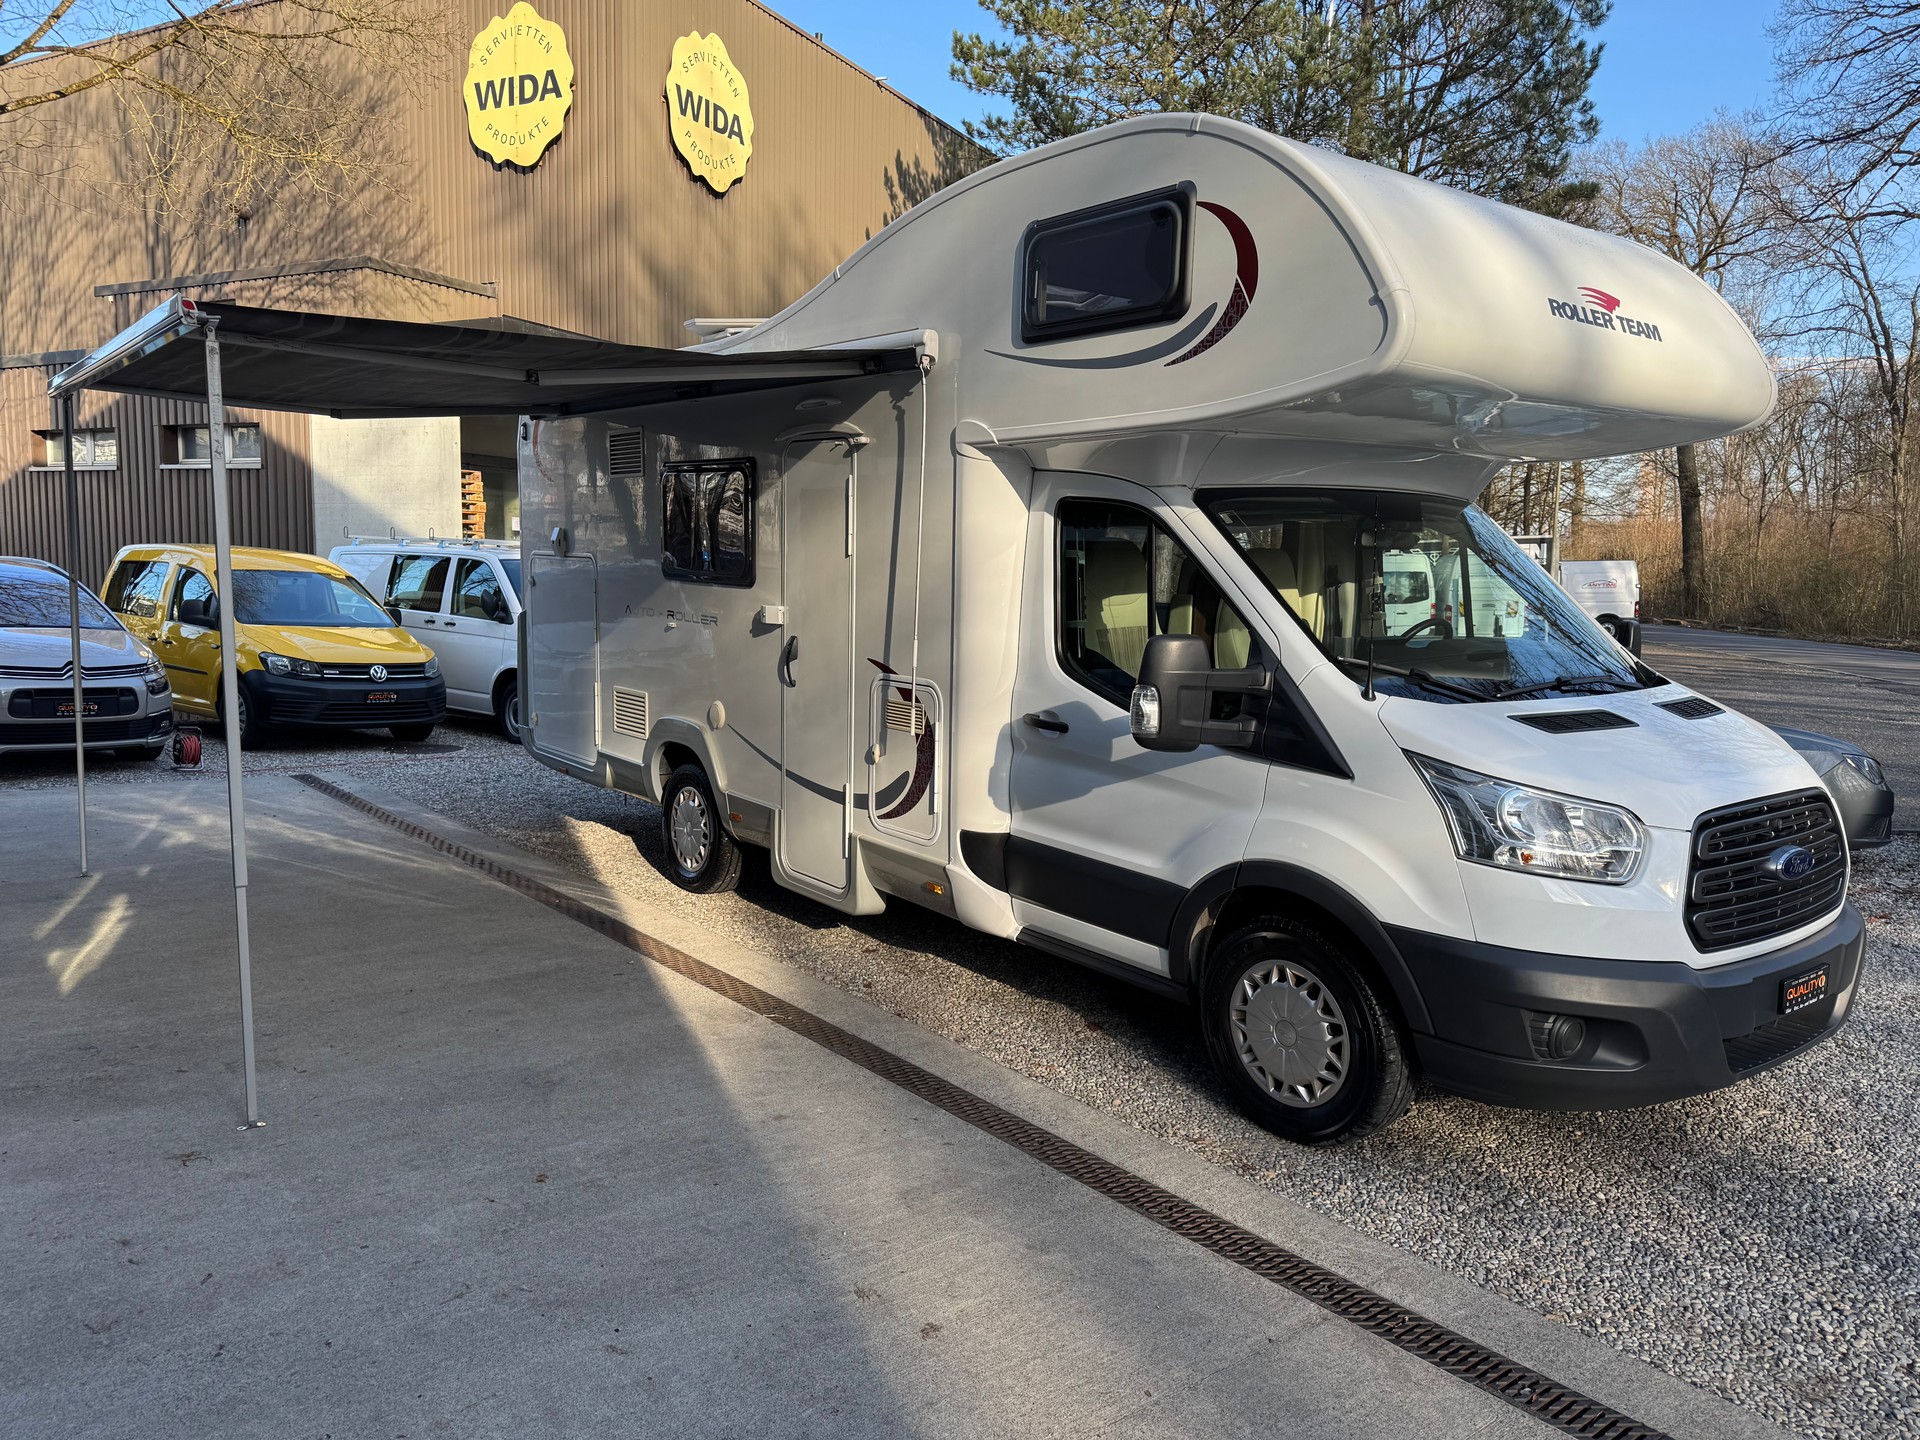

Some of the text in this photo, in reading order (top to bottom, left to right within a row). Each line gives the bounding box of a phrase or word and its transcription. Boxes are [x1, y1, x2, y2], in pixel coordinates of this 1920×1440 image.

[479, 25, 553, 66] SERVIETTEN
[474, 69, 563, 112] WIDA
[682, 51, 740, 98] SERVIETTEN
[485, 116, 550, 146] PRODUKTE
[675, 83, 745, 147] WIDA
[684, 130, 736, 170] PRODUKTE
[1547, 298, 1663, 342] ROLLER TEAM
[666, 609, 719, 626] ROLLER
